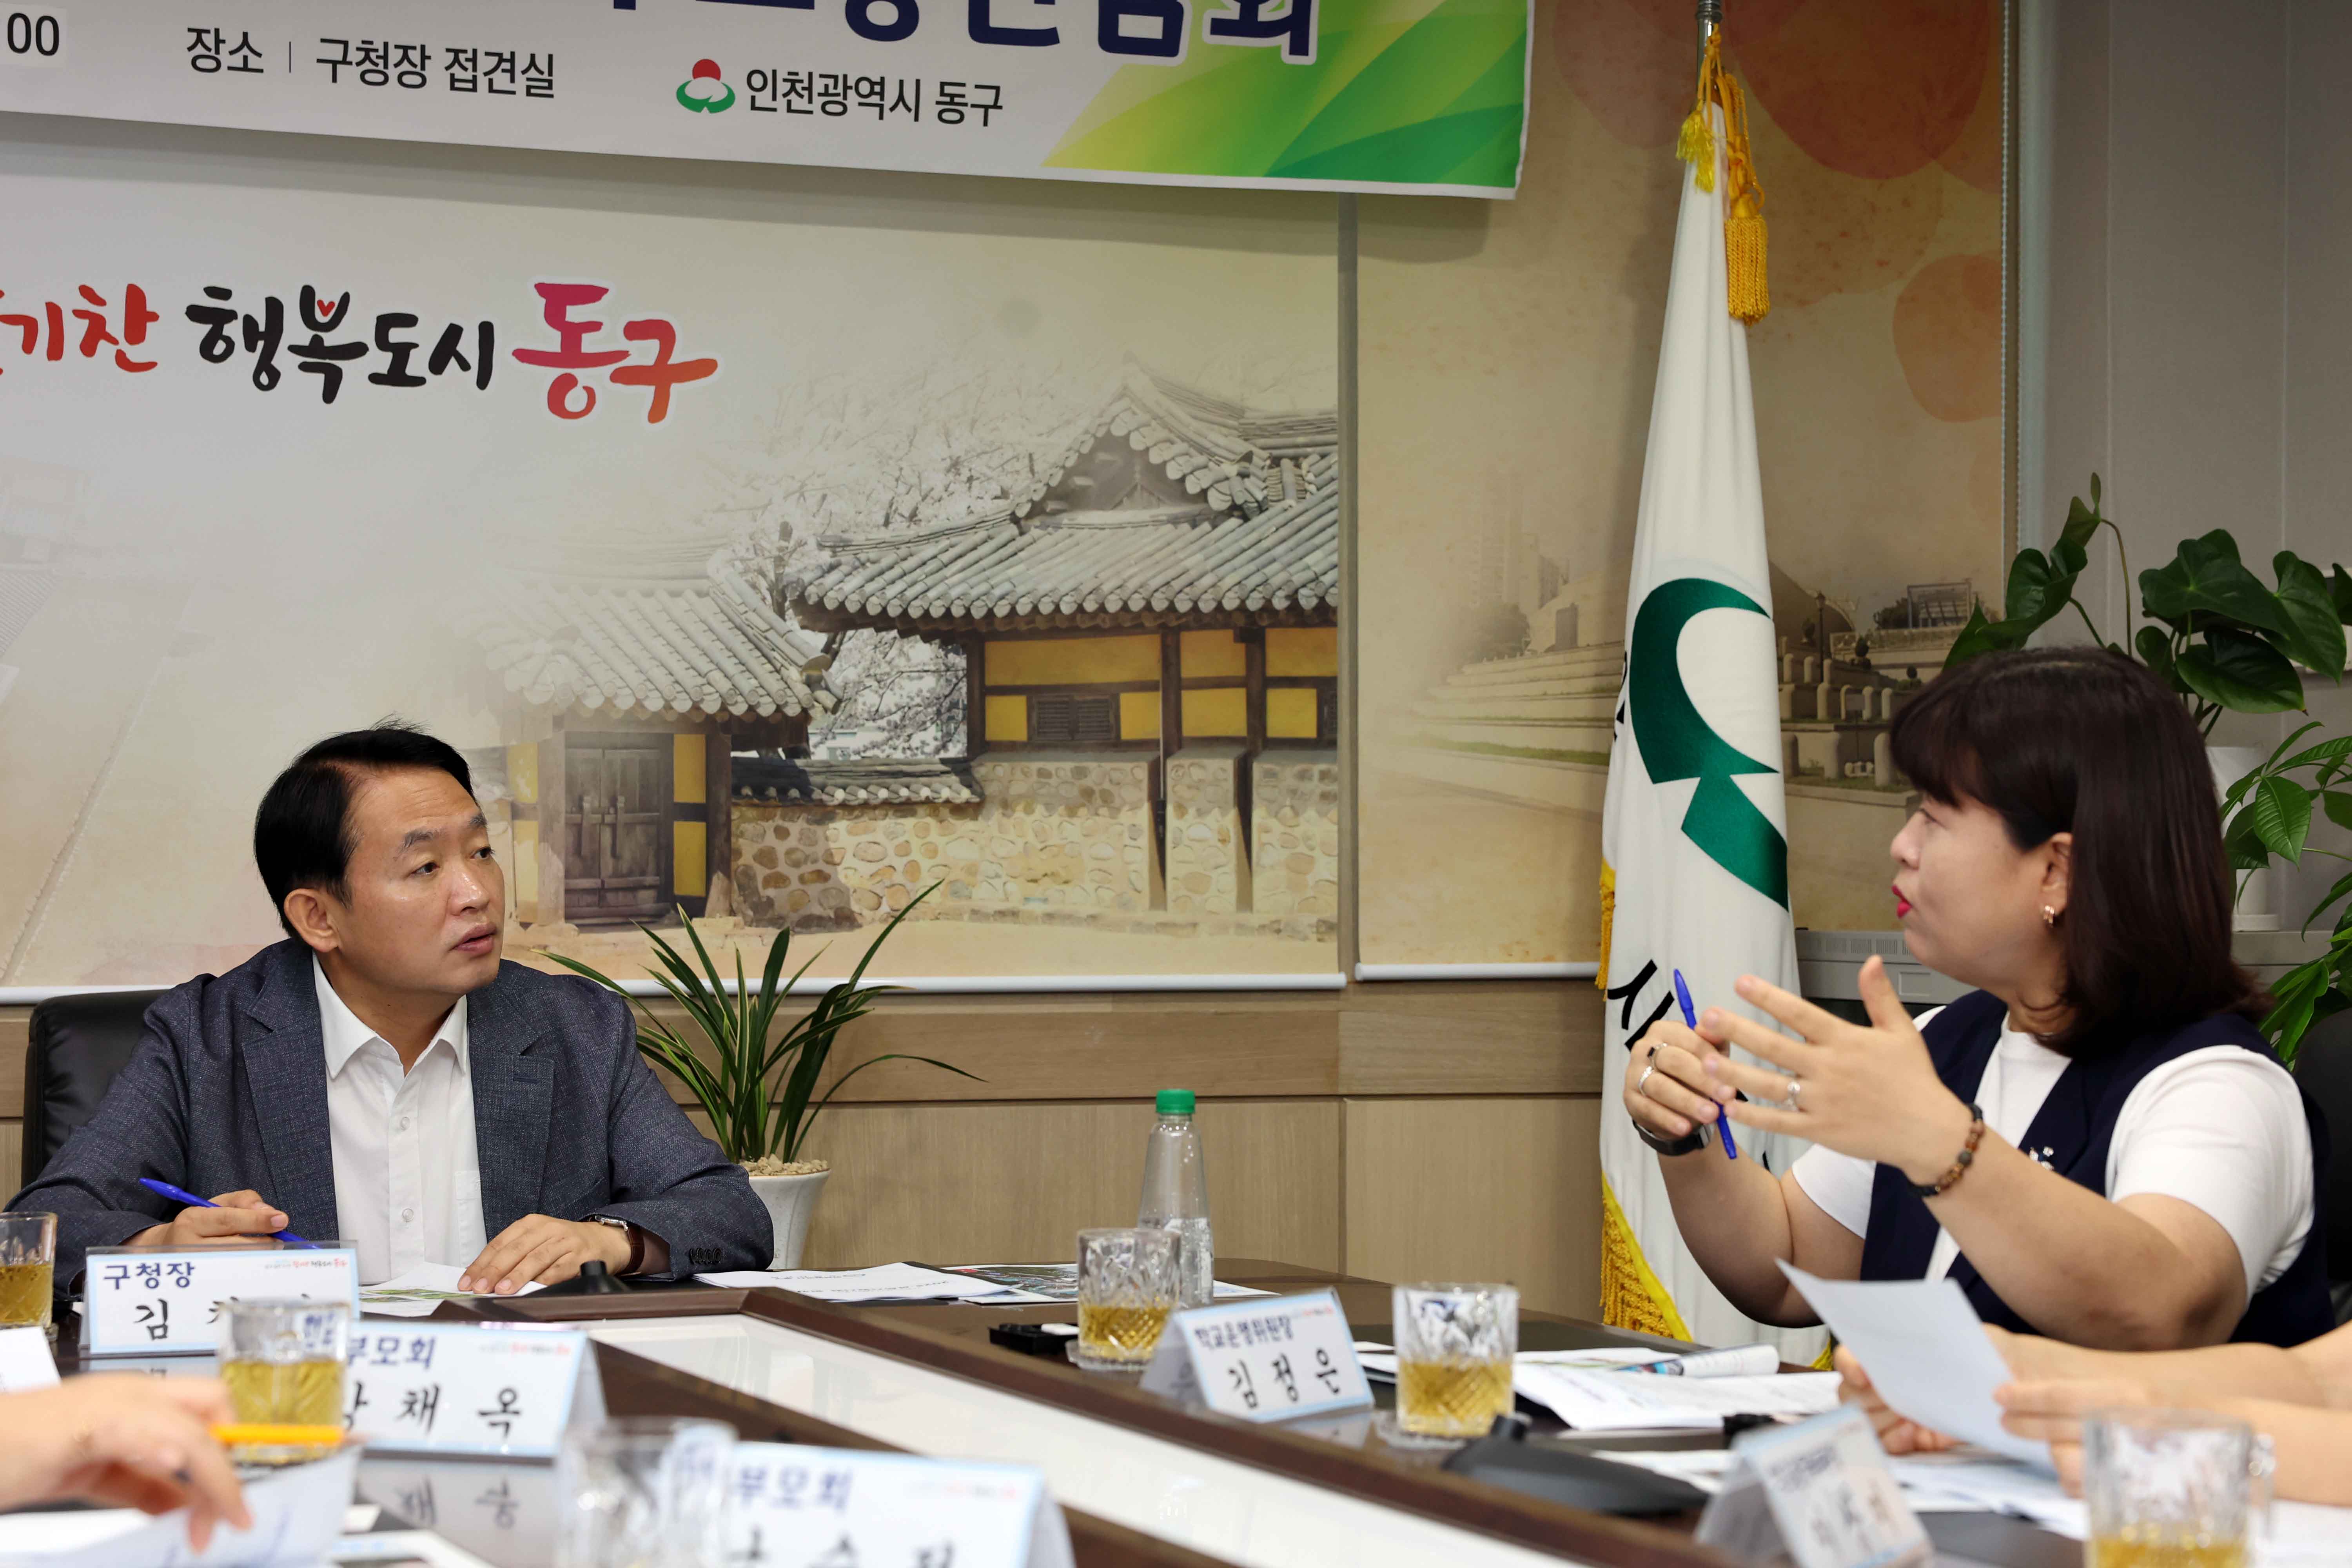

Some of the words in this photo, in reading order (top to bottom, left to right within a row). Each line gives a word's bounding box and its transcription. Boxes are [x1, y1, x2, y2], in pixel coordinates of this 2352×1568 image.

[7, 12, 60, 56] 00
[186, 27, 264, 74] 장소
[316, 38, 432, 89] 구청장
[444, 47, 554, 99] 접견실
[746, 69, 921, 122] 인천광역시
[935, 81, 1003, 127] 동구
[0, 283, 160, 376] 기찬
[185, 285, 495, 404] 행복도시
[511, 282, 719, 425] 동구
[103, 1261, 195, 1290] 구청장
[347, 1334, 435, 1368] 부모회
[737, 1463, 853, 1512] 부모회
